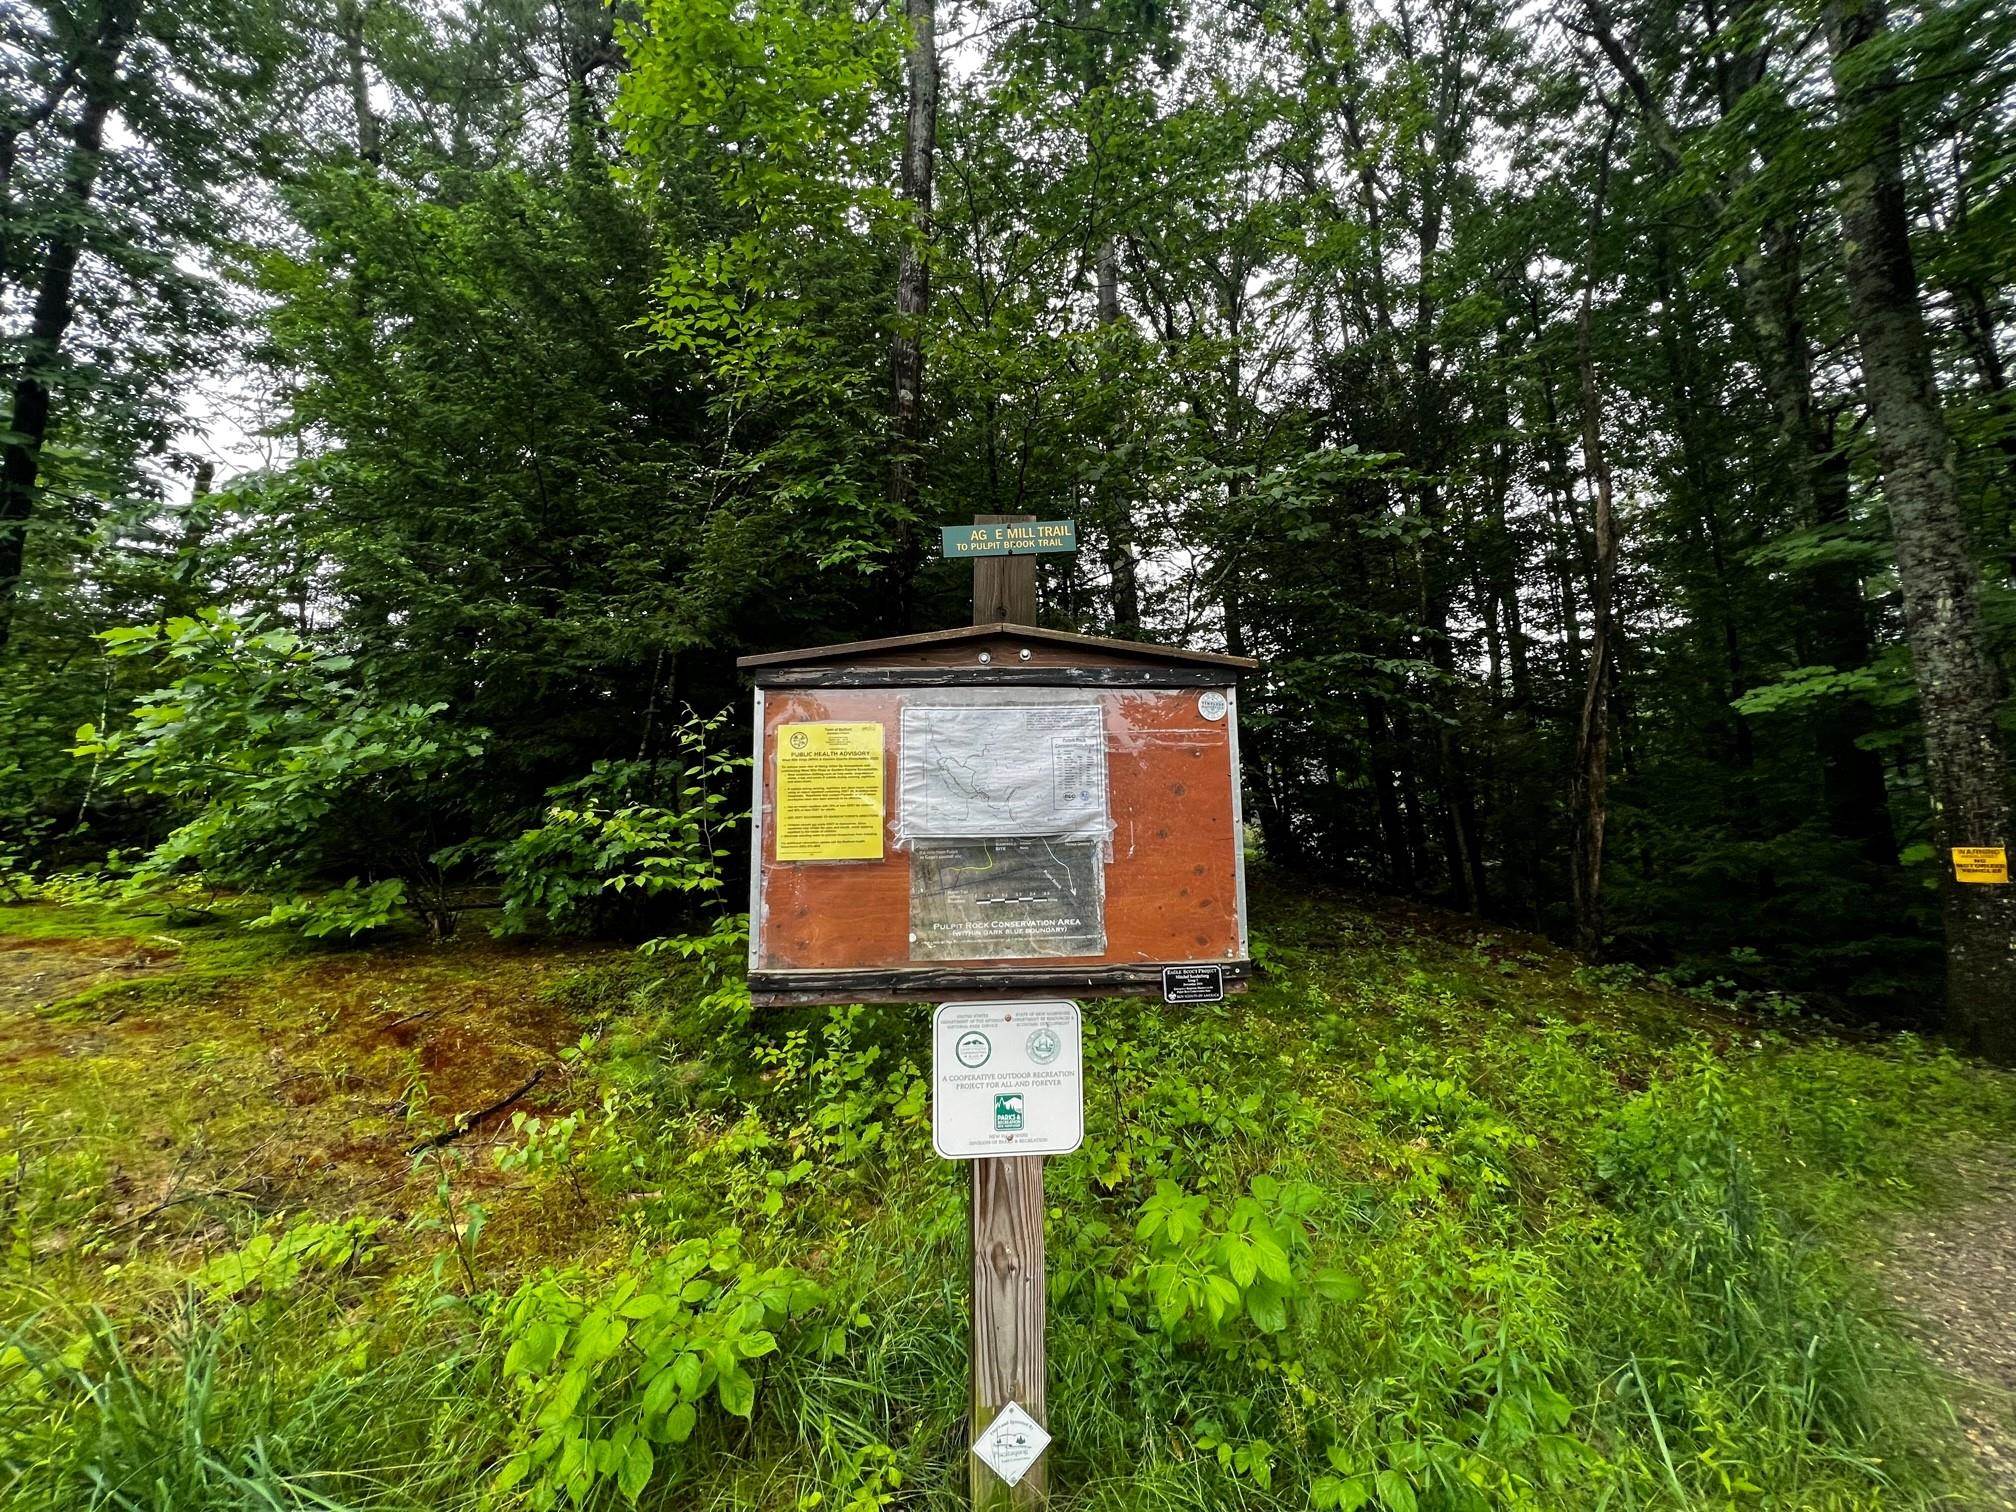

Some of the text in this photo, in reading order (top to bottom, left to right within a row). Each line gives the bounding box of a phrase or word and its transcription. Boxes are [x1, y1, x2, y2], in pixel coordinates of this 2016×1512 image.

[1007, 528, 1036, 539] MILL
[1037, 525, 1072, 538] TRAIL
[956, 538, 1064, 552] TO PULPIT BROOK TRAIL
[991, 920, 1056, 928] CONSERVATION
